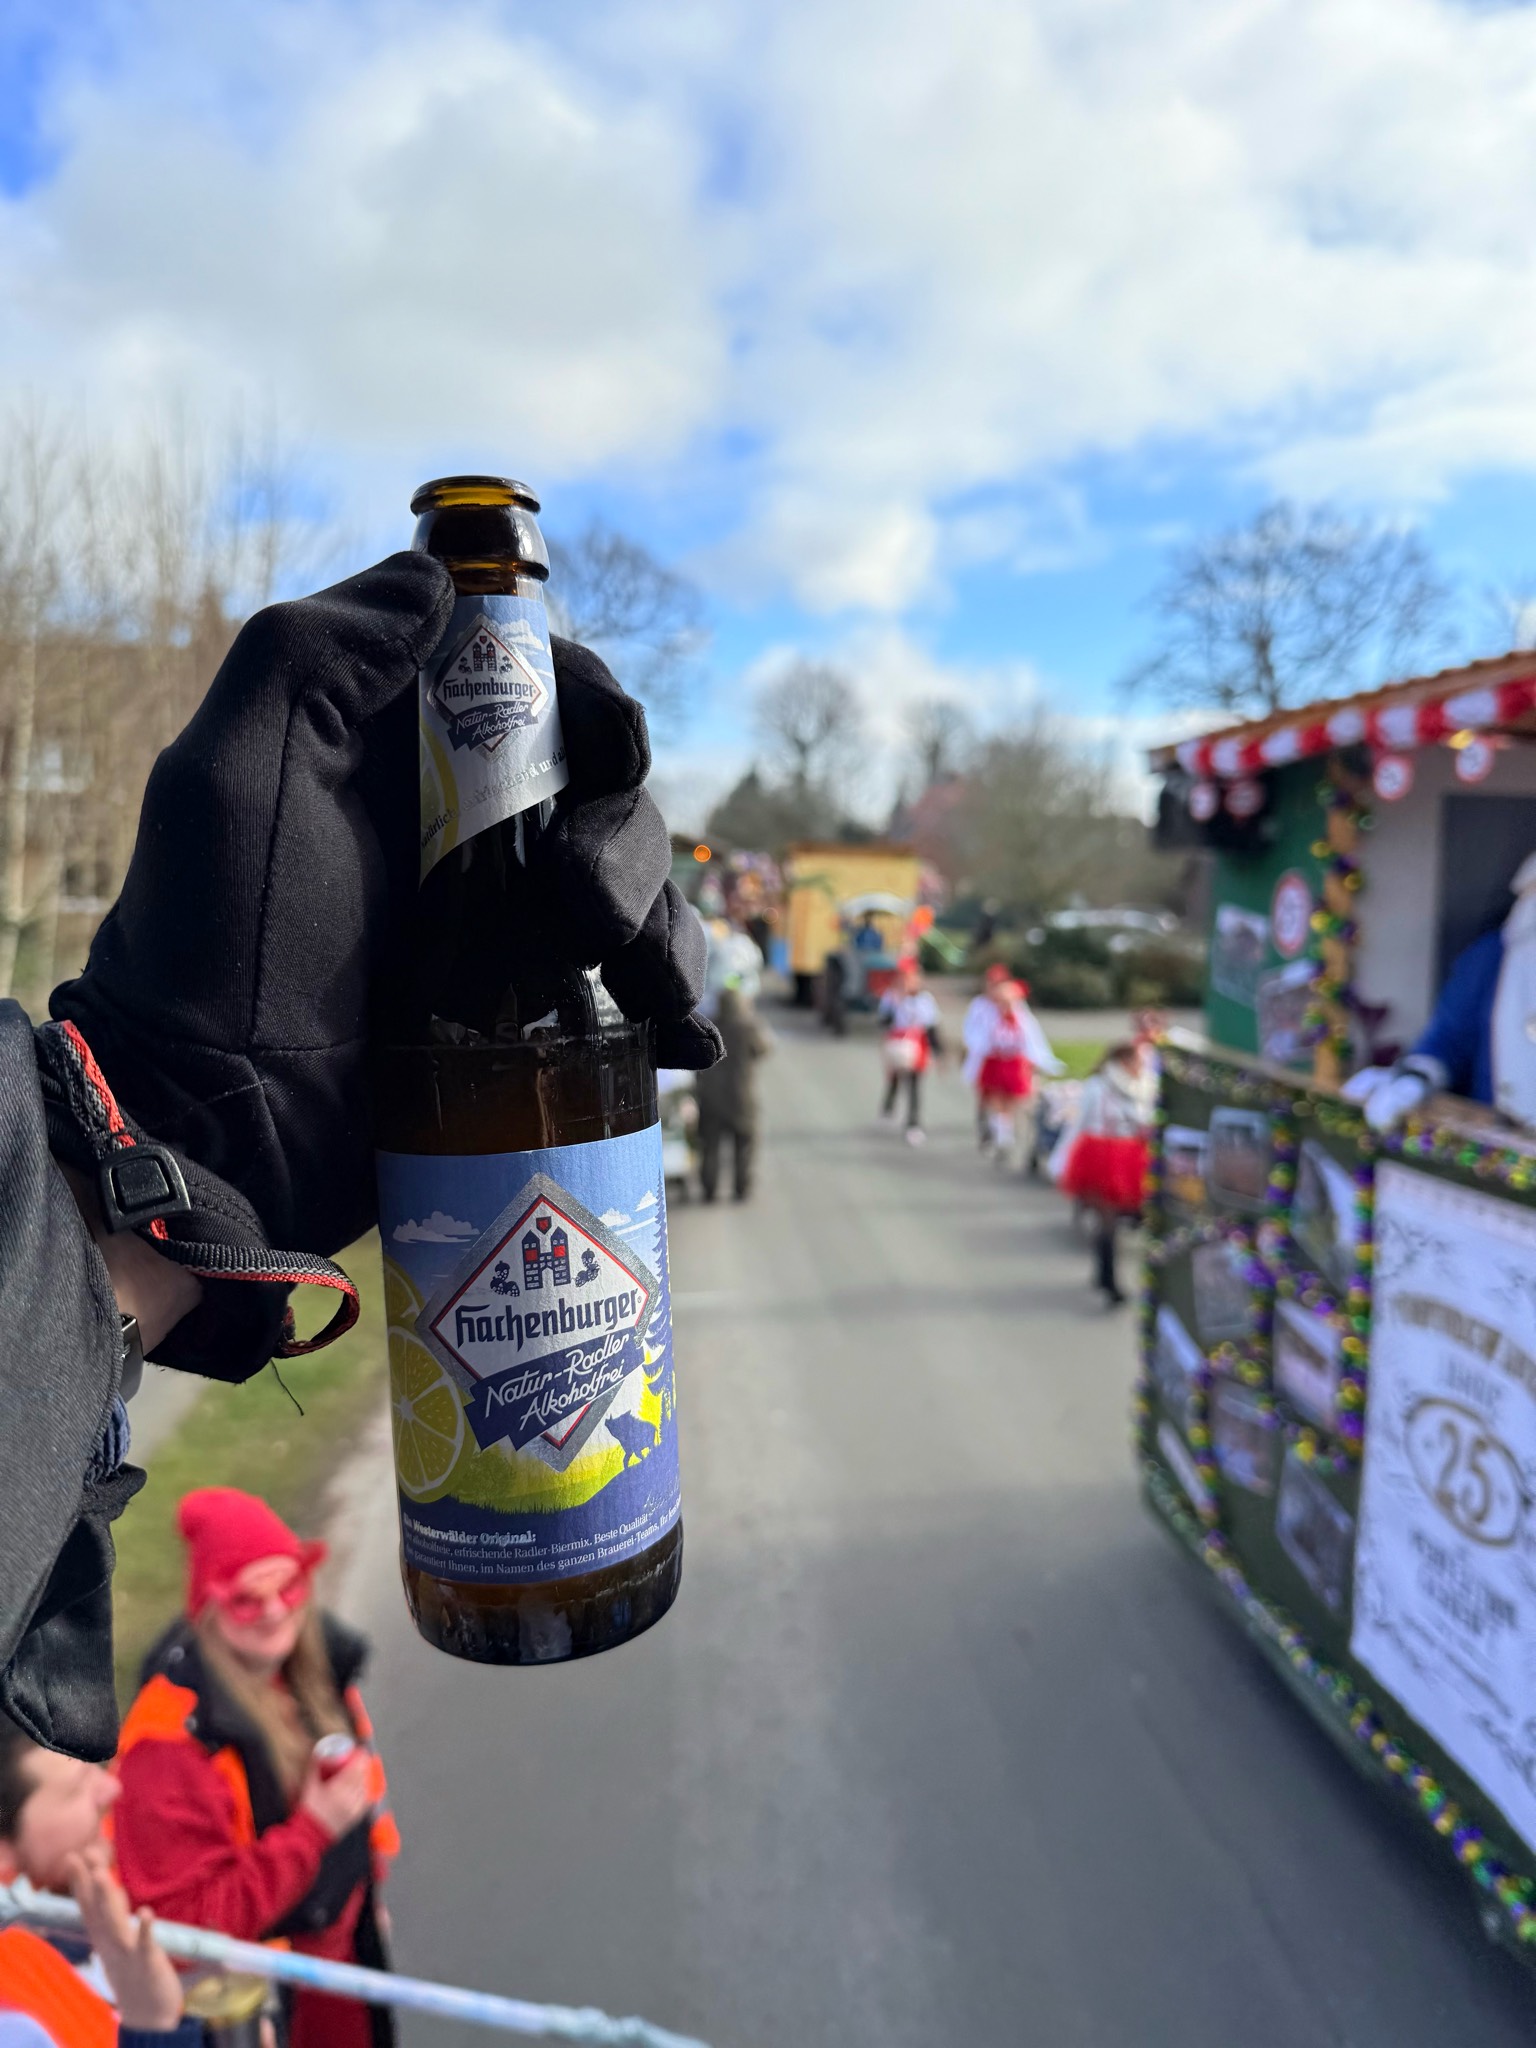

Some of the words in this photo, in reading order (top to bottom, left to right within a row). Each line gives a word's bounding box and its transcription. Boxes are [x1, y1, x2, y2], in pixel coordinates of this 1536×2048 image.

[443, 677, 534, 701] Hachenburger
[457, 702, 529, 735] Natur-Radler
[472, 716, 527, 740] Alkoholfrei
[539, 751, 558, 773] und
[455, 1288, 639, 1352] Hachenburger
[485, 1332, 630, 1418] Natur-Radler
[519, 1358, 625, 1430] Alkoholfrei
[1433, 1418, 1490, 1524] 25
[412, 1518, 479, 1545] Westerwälder
[479, 1529, 537, 1548] Original:
[448, 1559, 480, 1574] Ihnen,
[480, 1562, 494, 1574] im
[496, 1563, 535, 1575] Namen
[536, 1558, 556, 1572] des
[557, 1551, 595, 1570] ganzen
[597, 1521, 660, 1559] Brauerei-Teams,
[454, 1546, 513, 1560] erfrischende
[514, 1536, 593, 1558] Radler-Biermix.
[594, 1529, 618, 1545] Beste
[619, 1512, 649, 1535] Qualität
